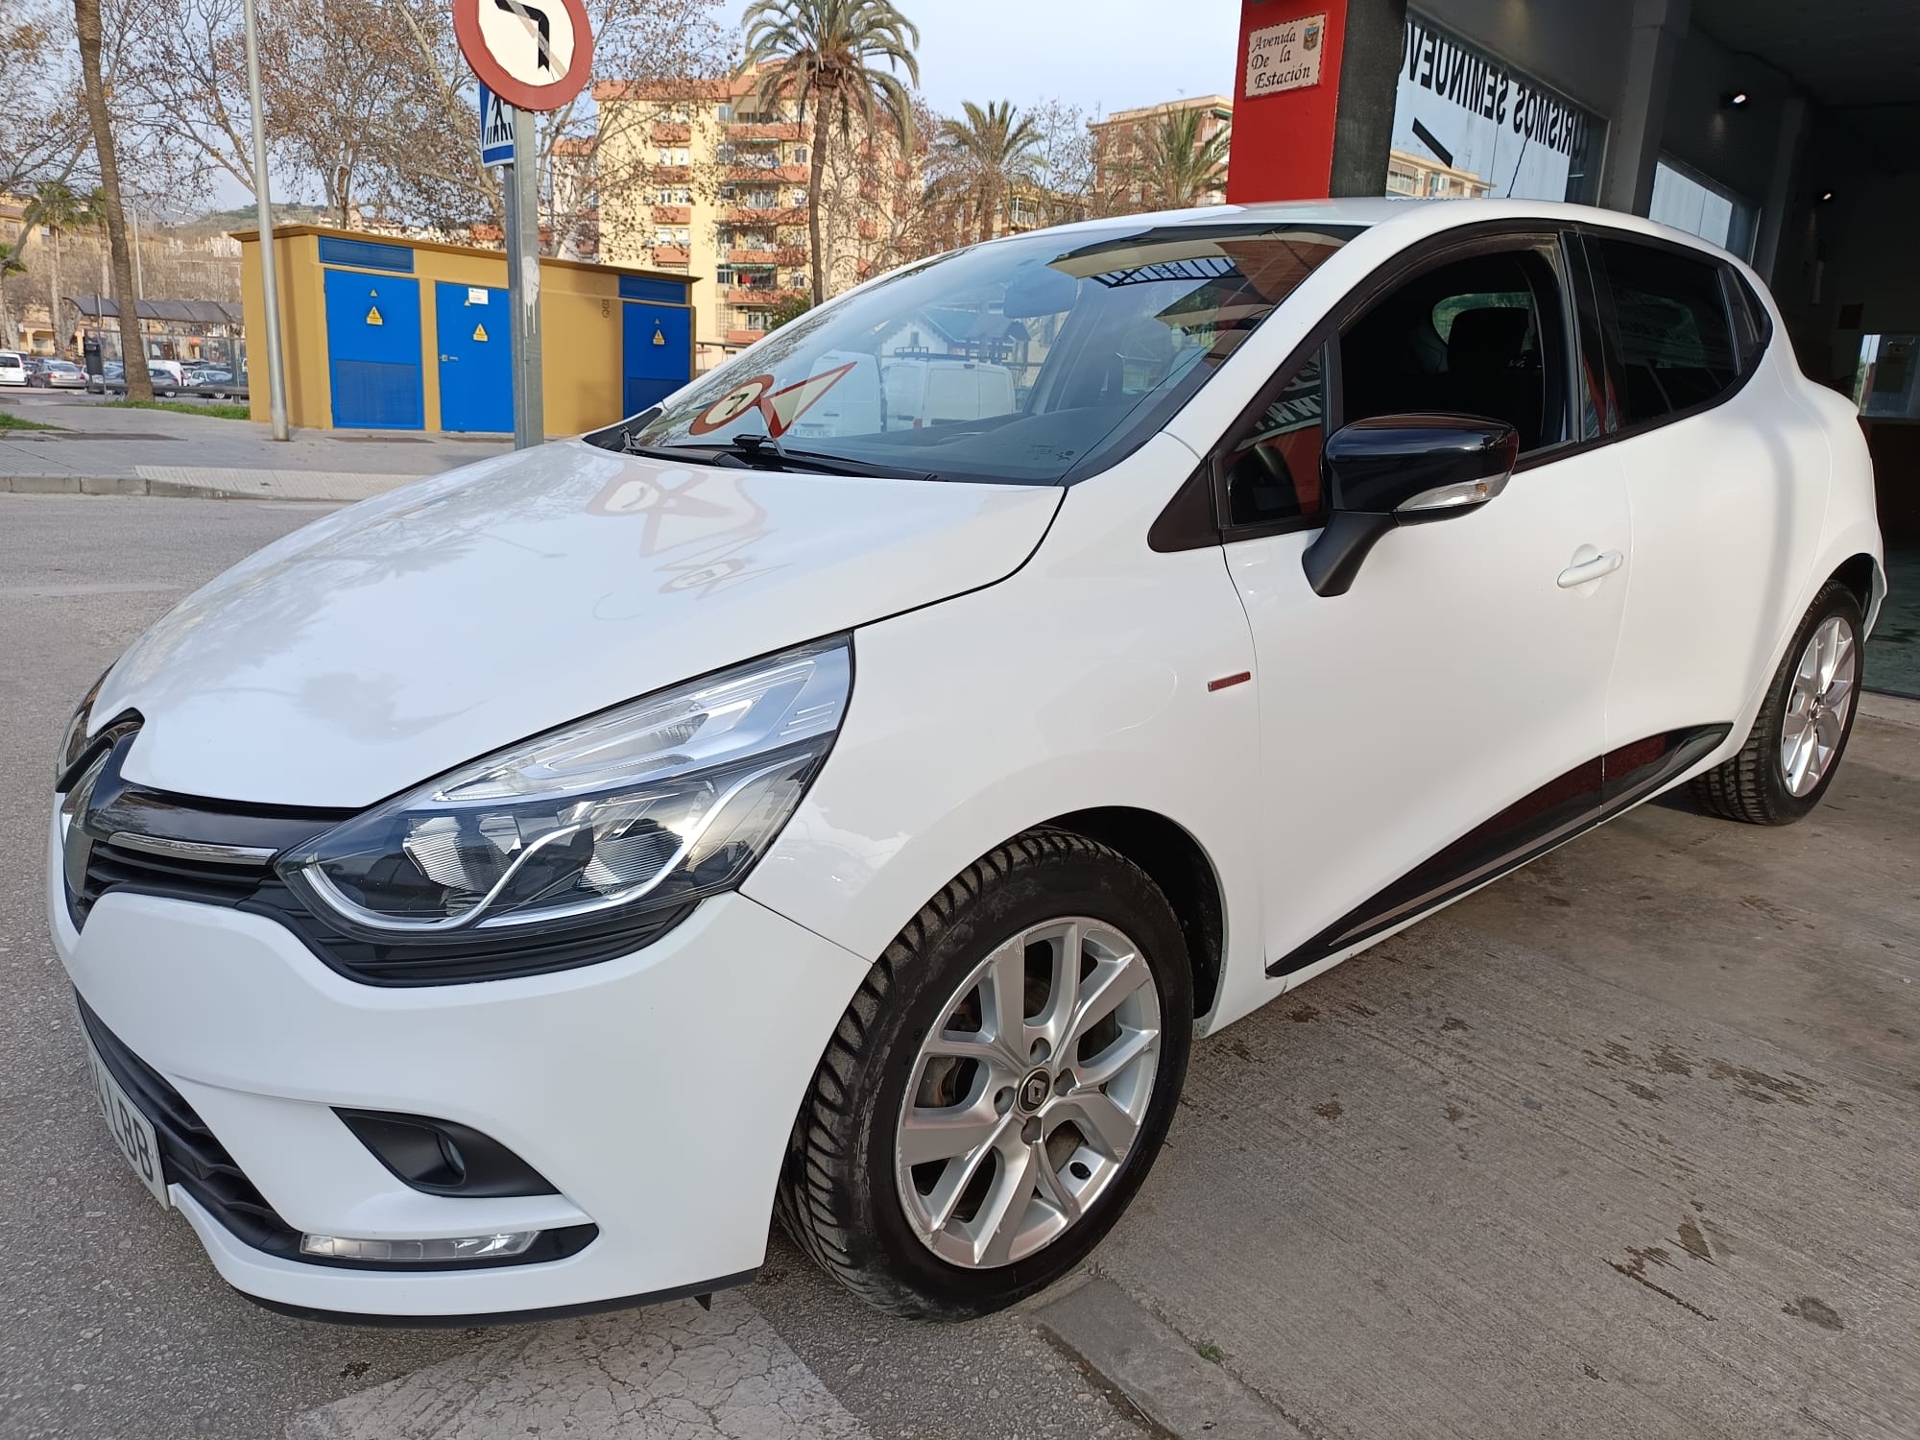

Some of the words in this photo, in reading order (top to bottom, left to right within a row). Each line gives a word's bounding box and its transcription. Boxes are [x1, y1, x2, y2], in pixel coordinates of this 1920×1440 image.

[1253, 28, 1296, 53] Avenida
[1251, 54, 1270, 70] De
[1280, 45, 1291, 64] la
[1255, 63, 1311, 88] Estación
